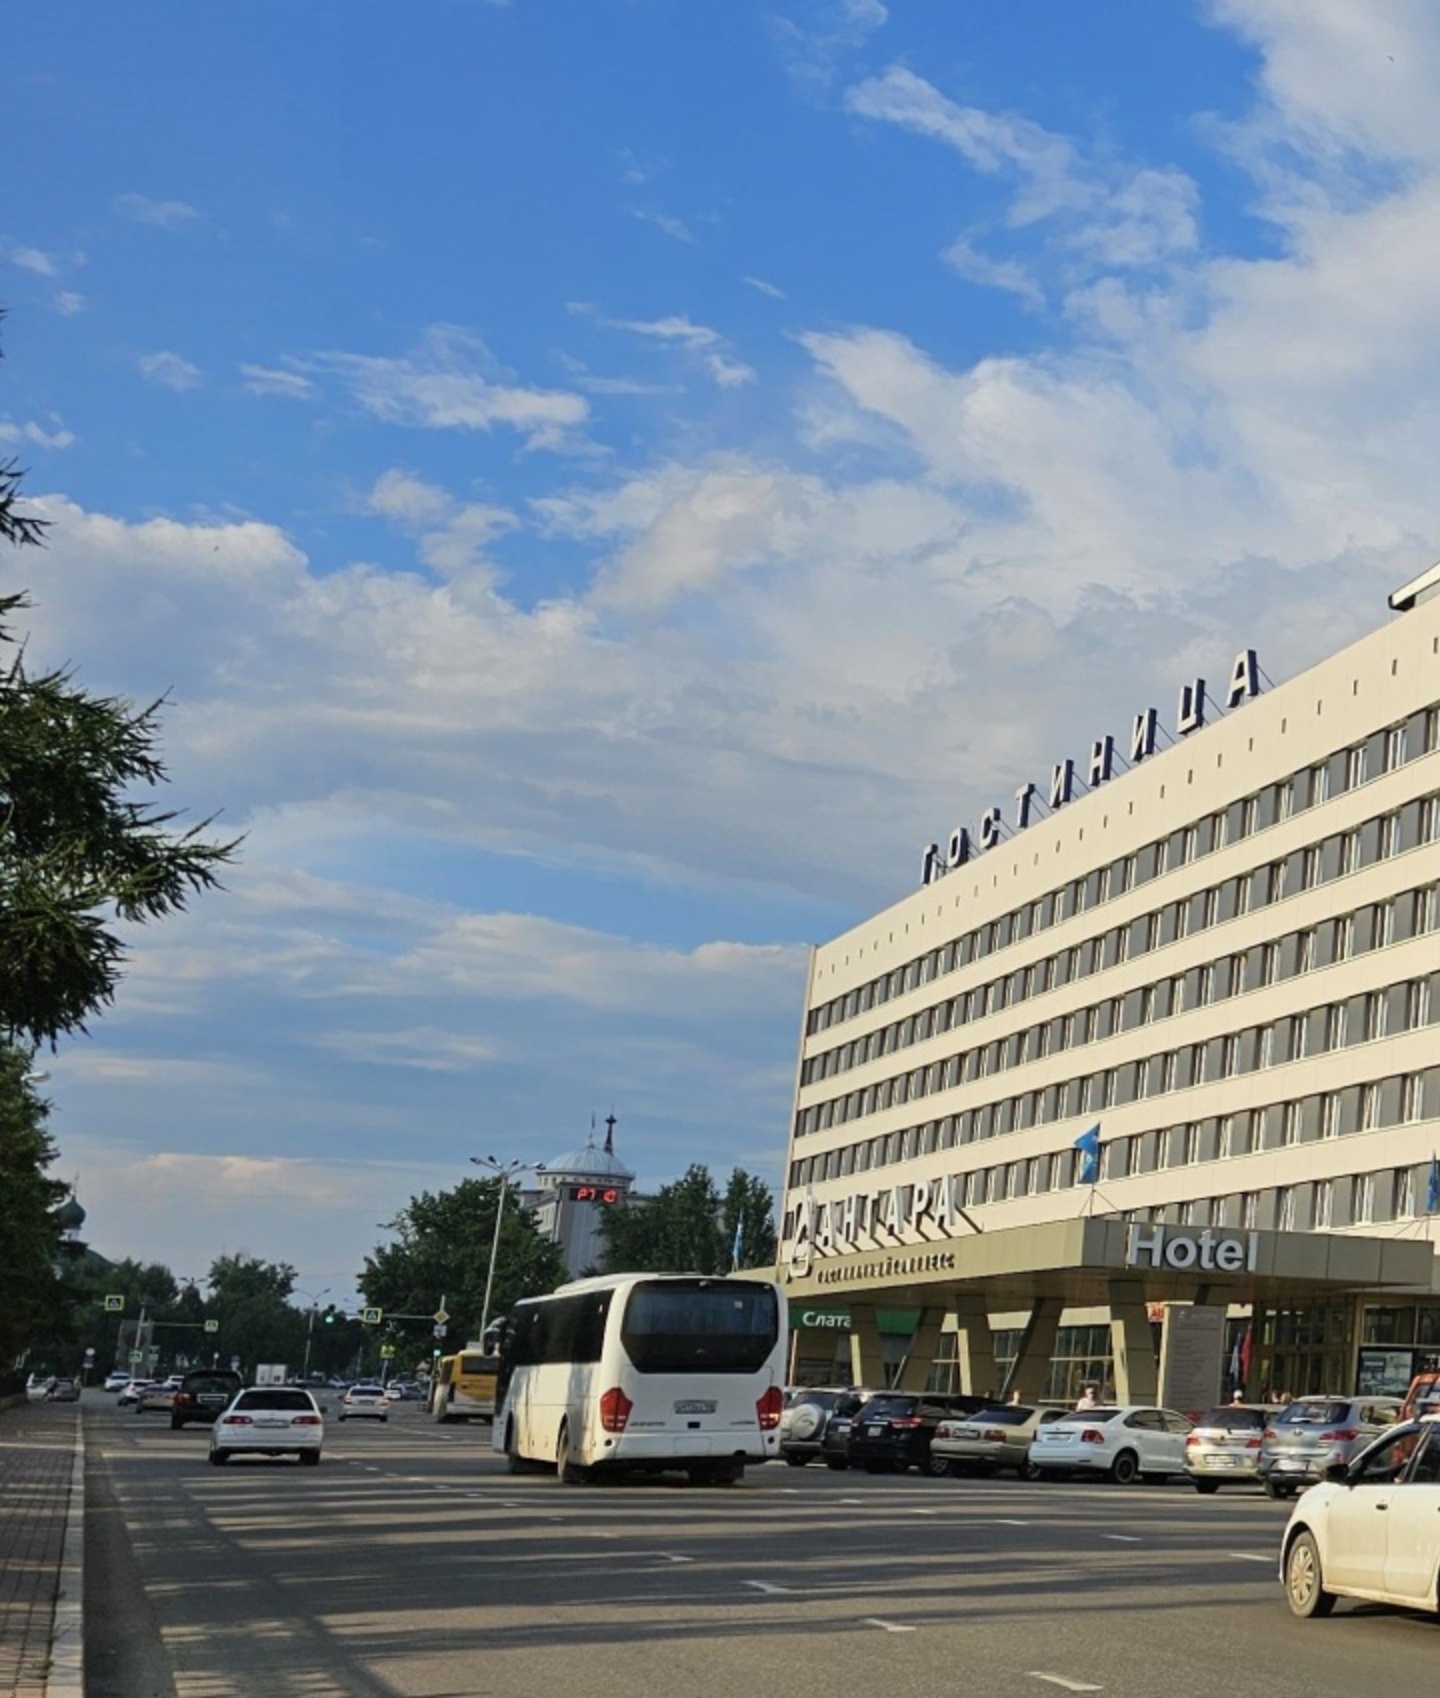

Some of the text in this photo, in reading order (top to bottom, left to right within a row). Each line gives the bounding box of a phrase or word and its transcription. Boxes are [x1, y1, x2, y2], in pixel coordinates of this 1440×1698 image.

[920, 649, 1258, 885] ГОСТИНИЦА
[820, 1173, 956, 1248] АНГАРА
[1127, 1223, 1260, 1272] Hotel
